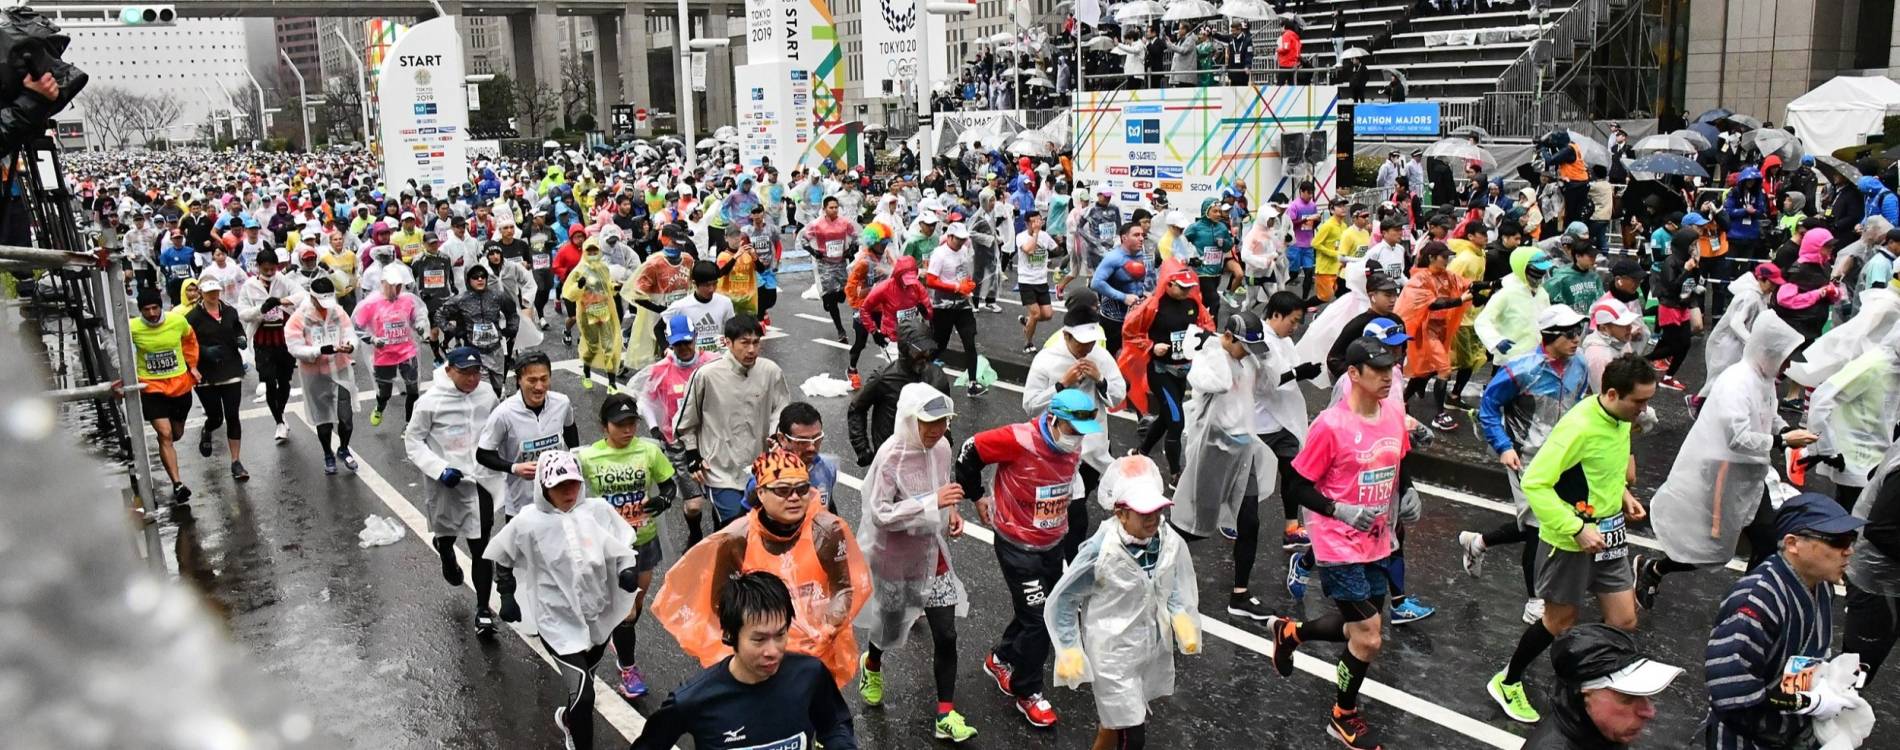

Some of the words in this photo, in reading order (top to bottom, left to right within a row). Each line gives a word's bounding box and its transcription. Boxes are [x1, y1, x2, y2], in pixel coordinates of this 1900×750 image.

[751, 8, 772, 18] TOKYO
[752, 27, 772, 42] 2019
[785, 8, 799, 61] START
[879, 40, 905, 55] TOKYO
[399, 55, 442, 67] START
[1395, 115, 1432, 125] MAJORS
[1160, 182, 1182, 190] SEIKO
[1190, 183, 1212, 191] SECOM
[595, 469, 646, 485] TOKYO
